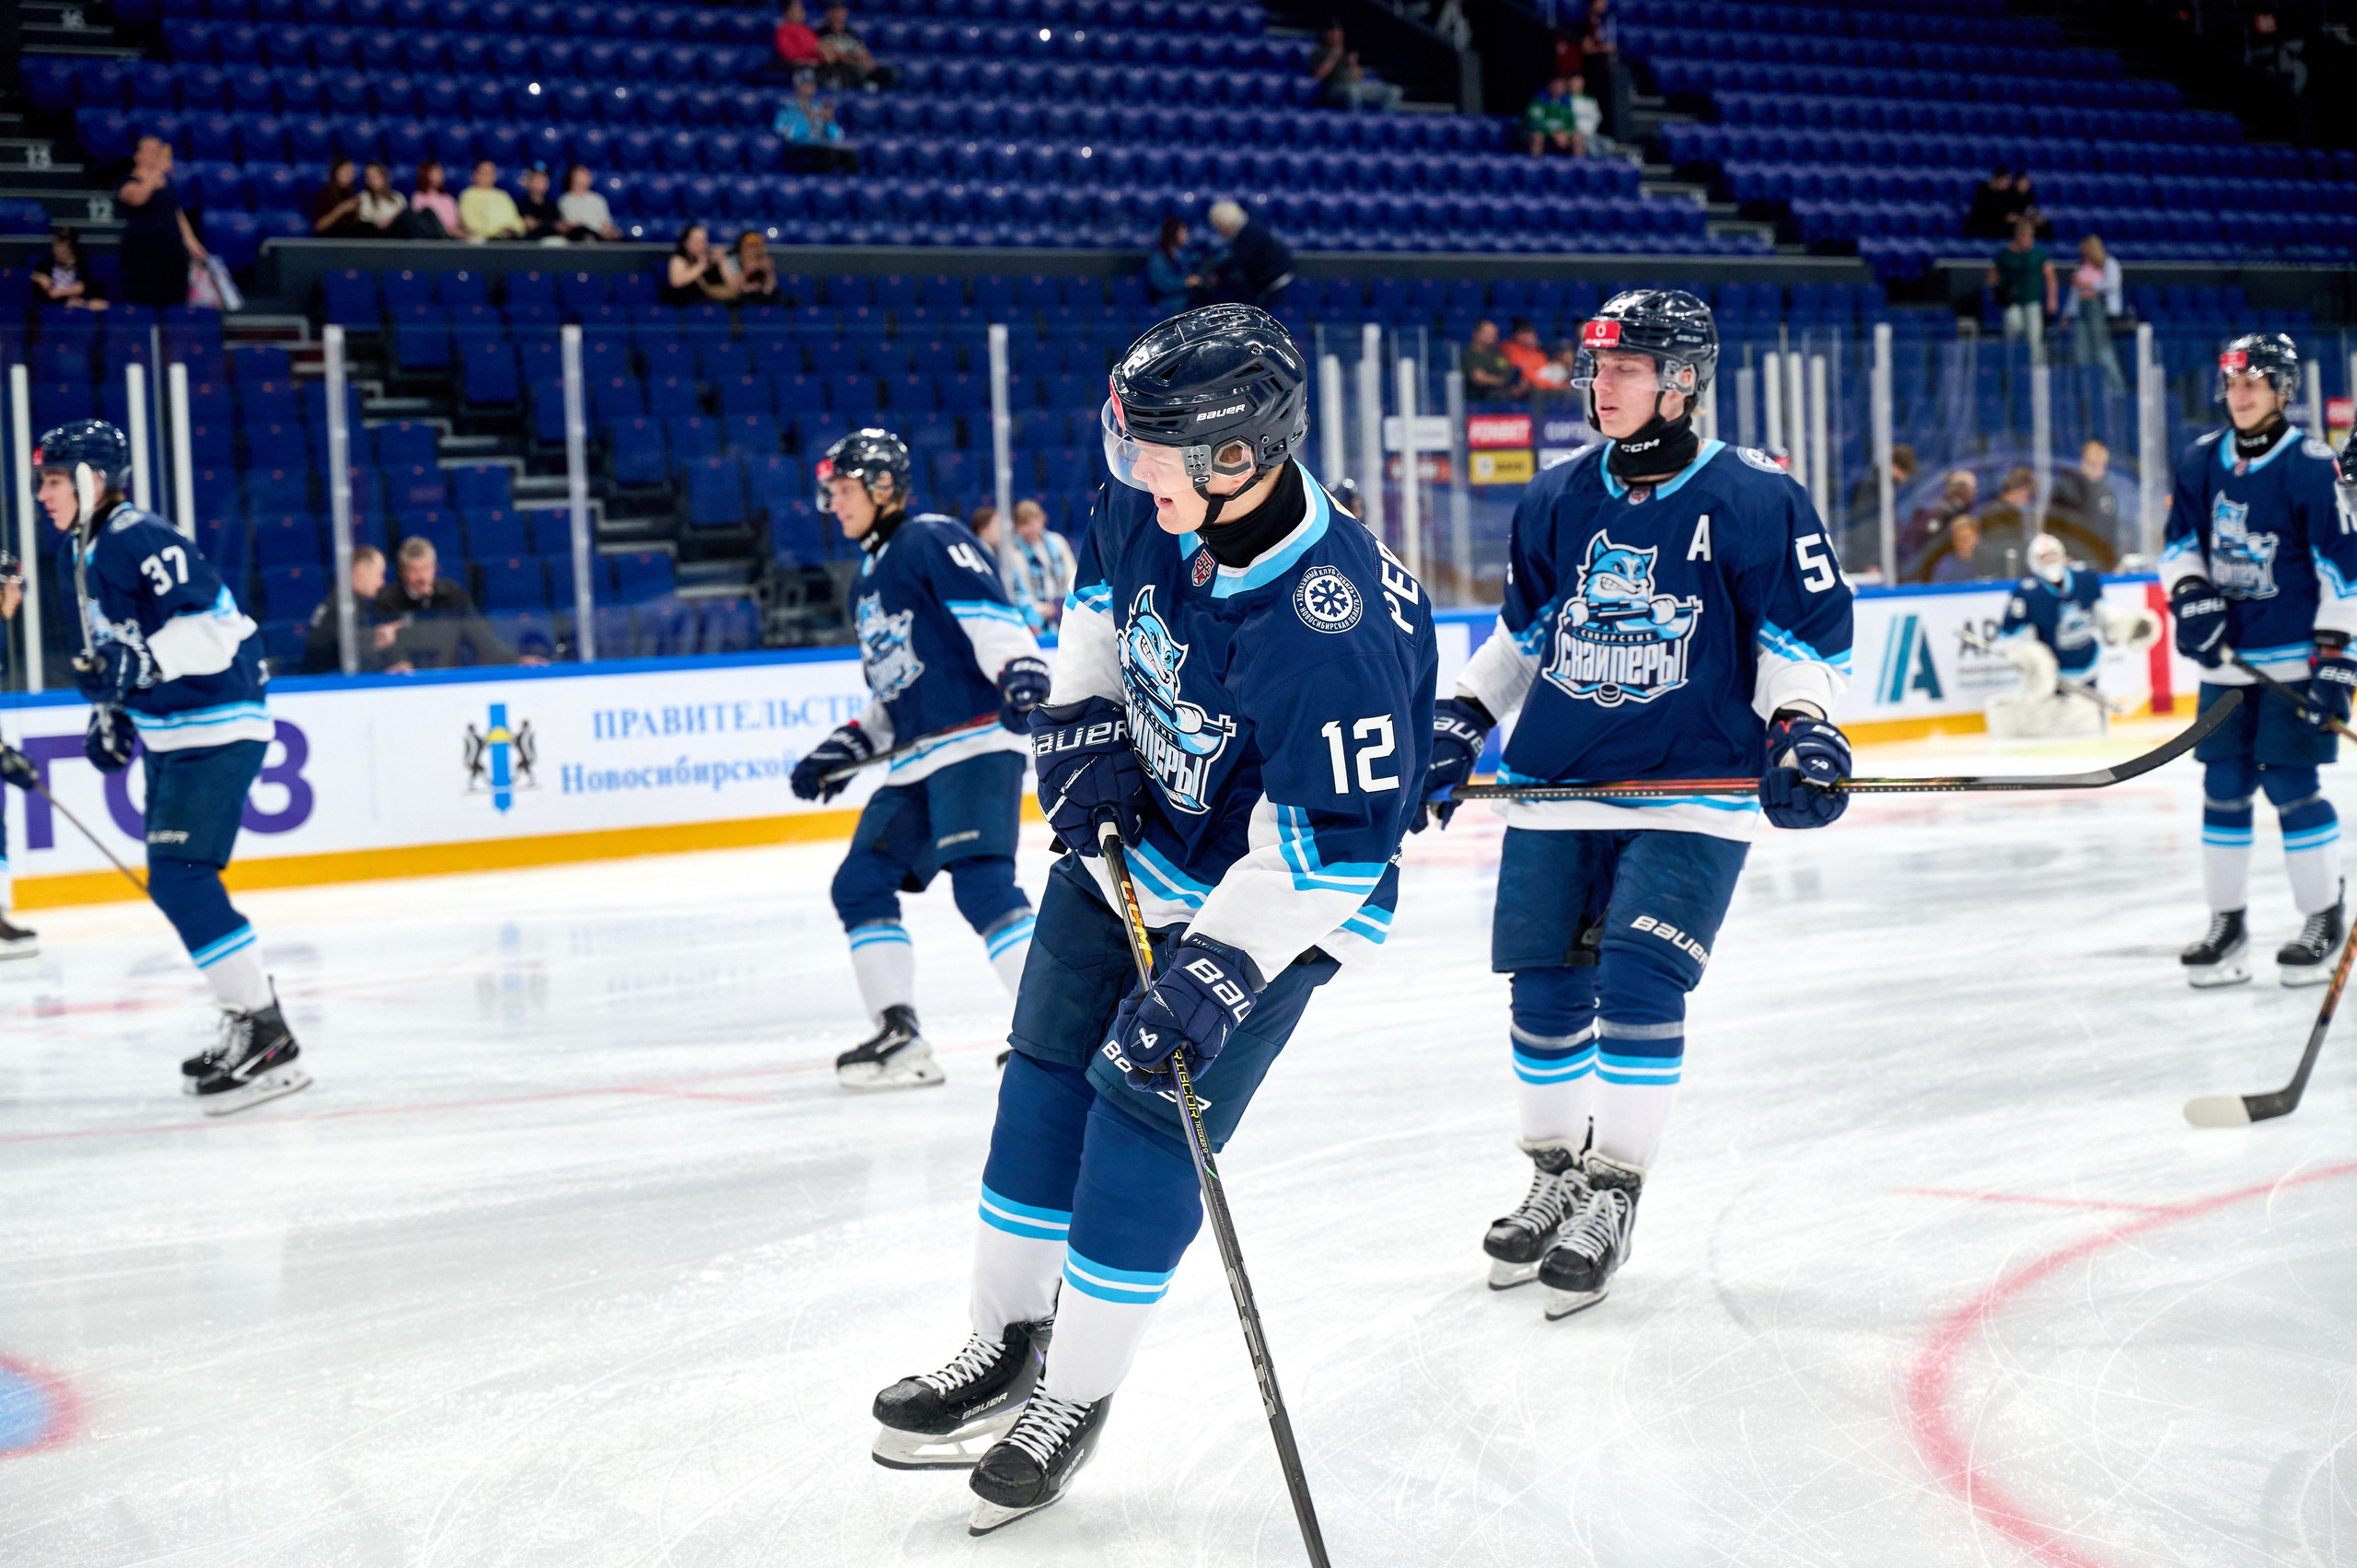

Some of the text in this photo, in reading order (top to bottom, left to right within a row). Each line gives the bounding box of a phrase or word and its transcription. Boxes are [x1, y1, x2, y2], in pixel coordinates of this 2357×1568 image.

[1196, 403, 1247, 423] BAUER
[1620, 437, 1661, 453] CCM
[1687, 514, 1713, 562] A
[140, 544, 190, 597] 37
[1318, 567, 1336, 576] КЛУБ
[1299, 606, 1350, 631] НОВОСИБИРСКАЯ
[1580, 630, 1654, 643] СИБИРСКИЕ
[1030, 718, 1130, 758] AUER
[1321, 714, 1399, 794] 12
[1172, 1049, 1200, 1119] RIBCOR
[961, 1391, 1008, 1421] BAUER
